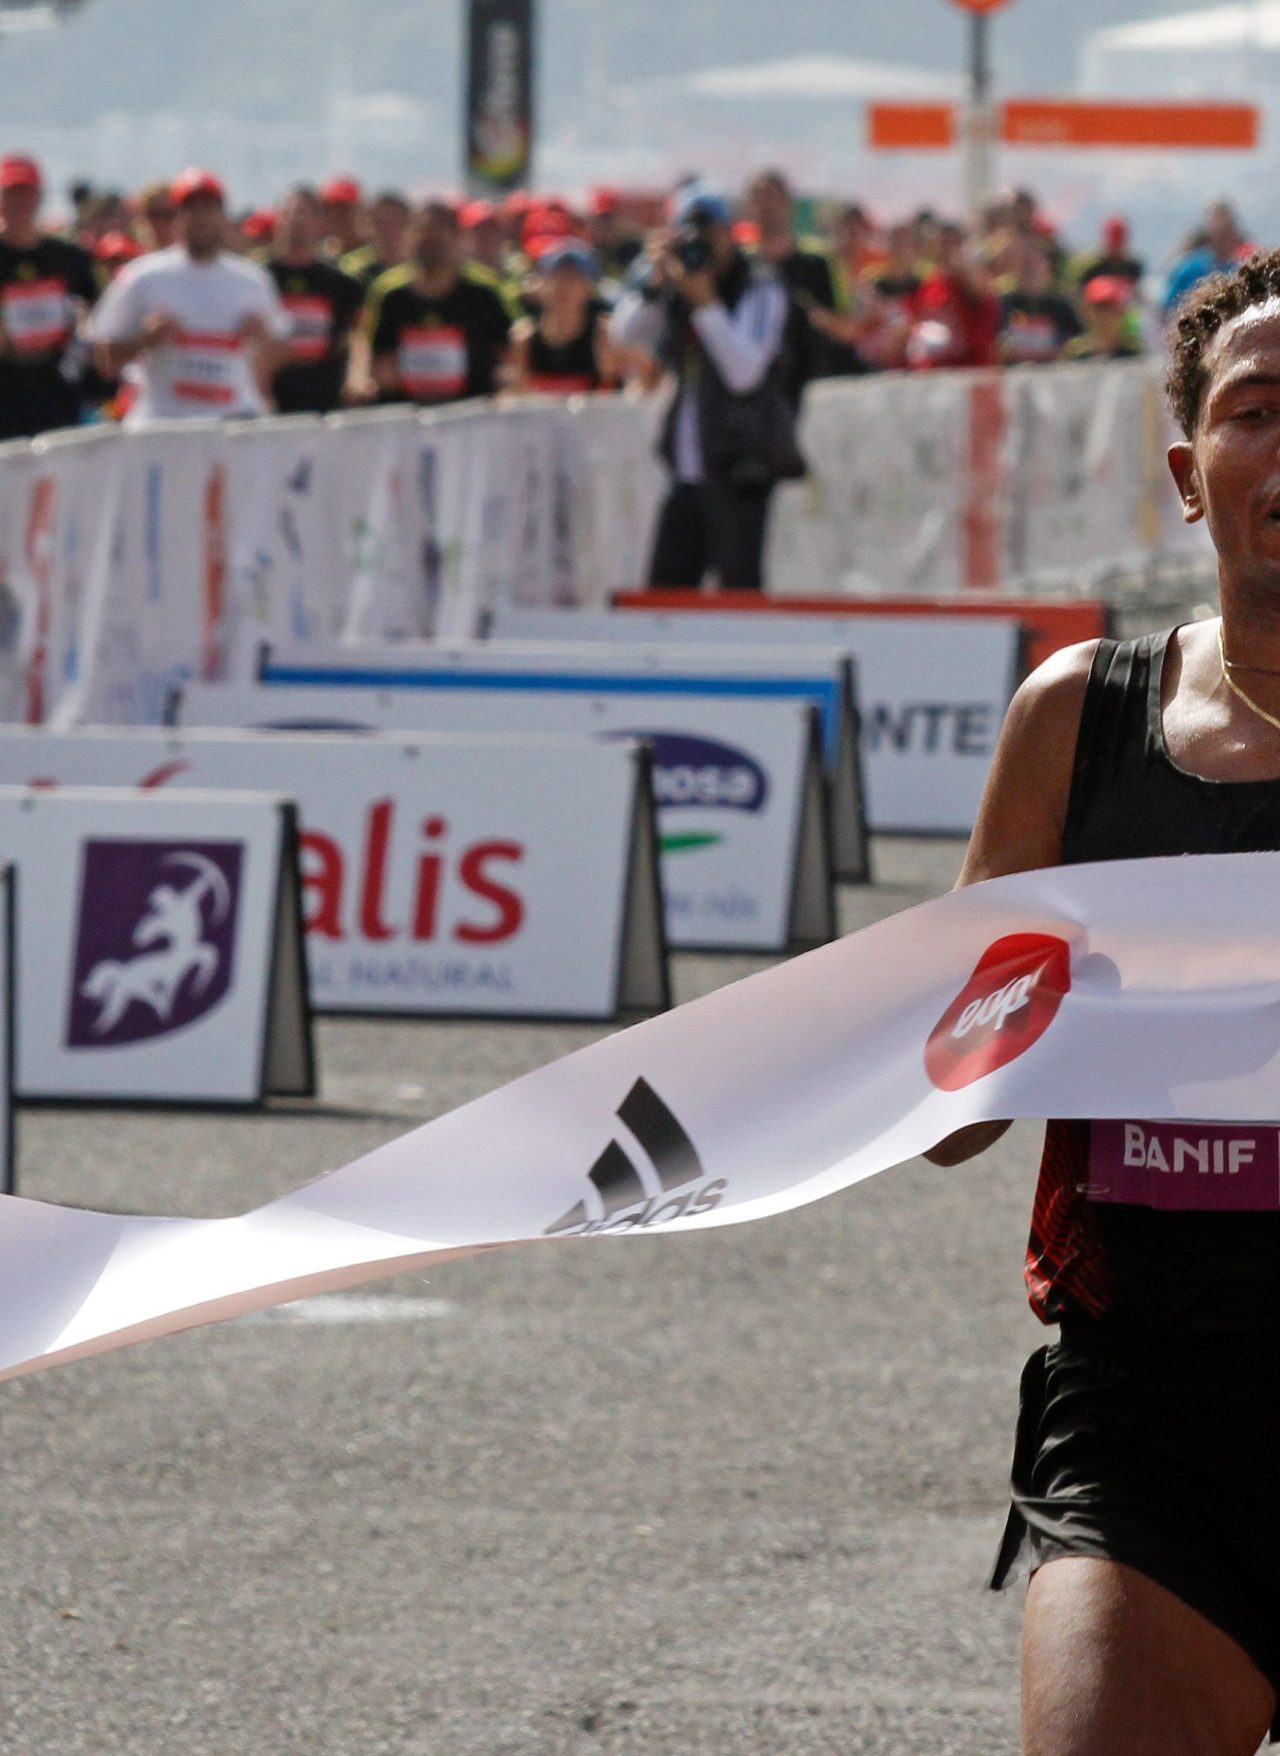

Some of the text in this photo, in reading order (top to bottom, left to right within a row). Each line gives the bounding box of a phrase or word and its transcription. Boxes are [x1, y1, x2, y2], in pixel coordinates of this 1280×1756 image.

[870, 702, 993, 755] NTE
[299, 797, 525, 944] alis
[1123, 1122, 1256, 1175] BANIF
